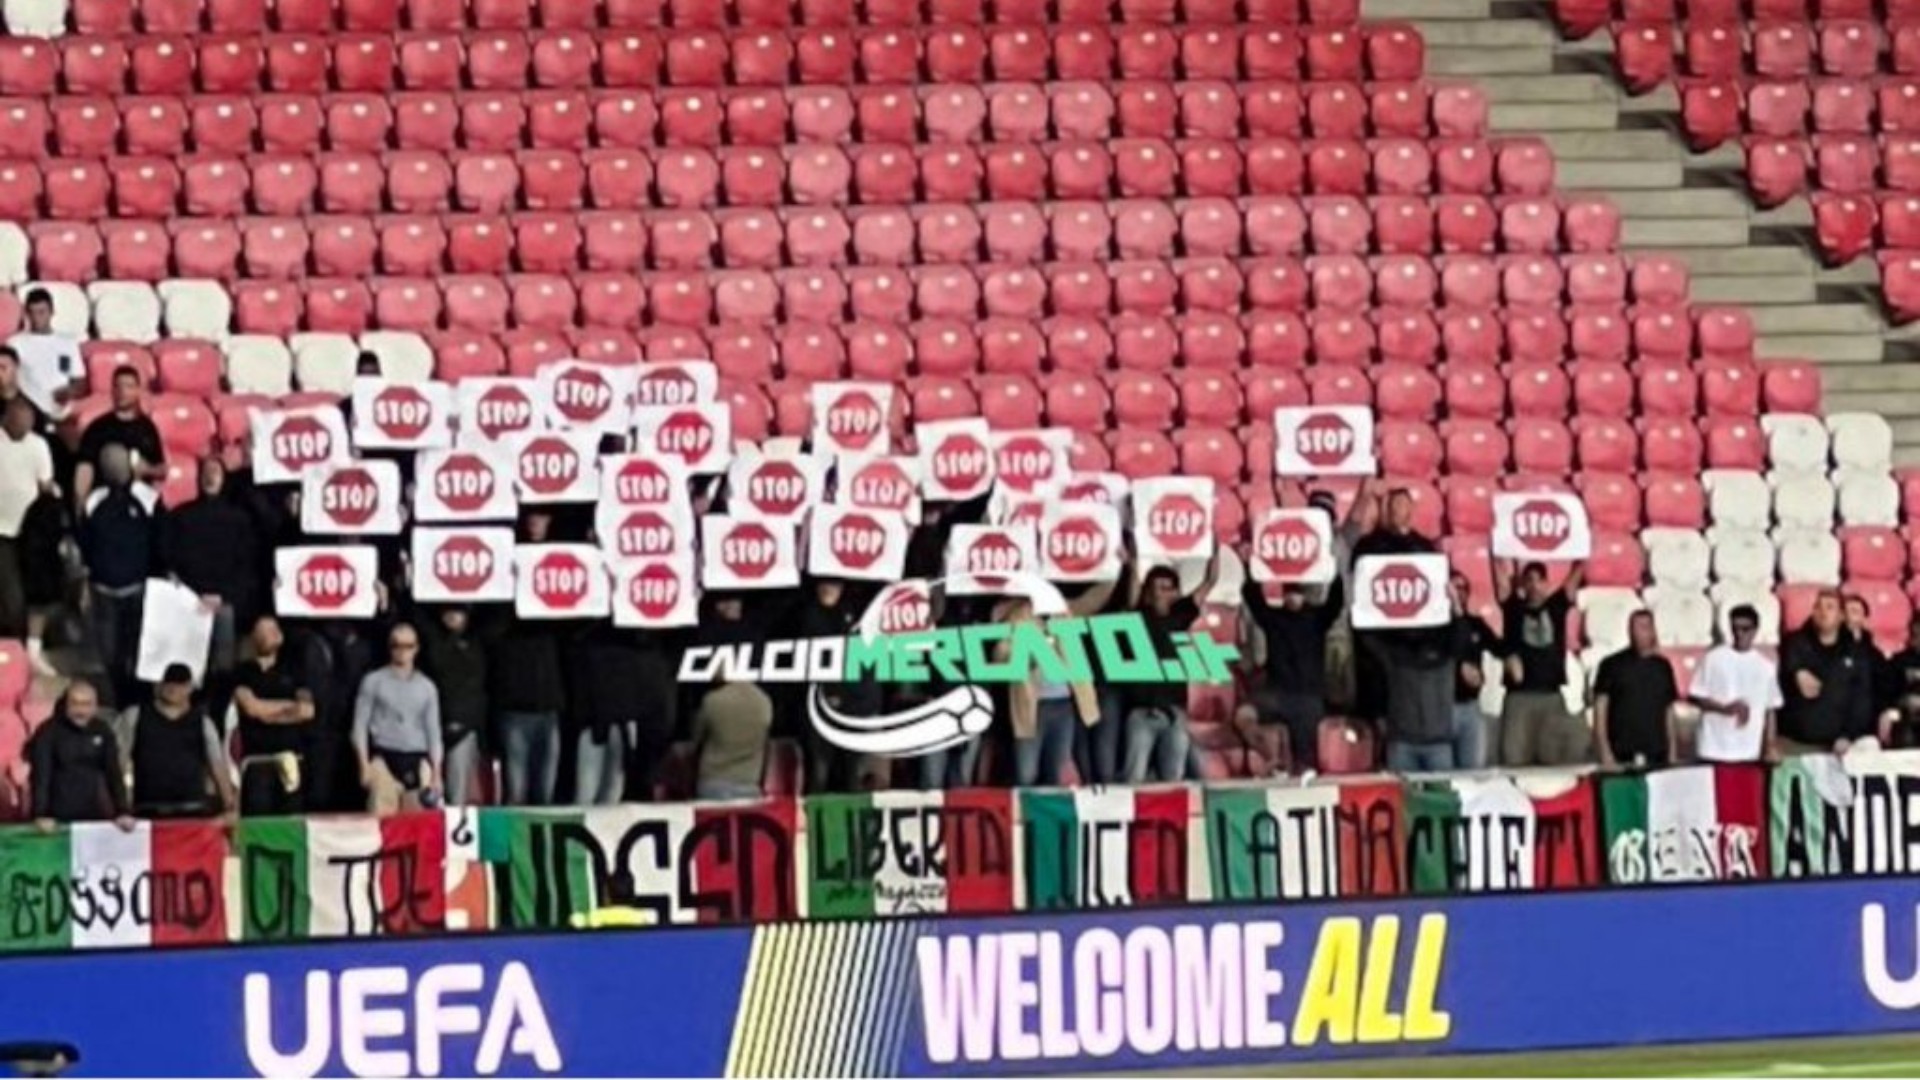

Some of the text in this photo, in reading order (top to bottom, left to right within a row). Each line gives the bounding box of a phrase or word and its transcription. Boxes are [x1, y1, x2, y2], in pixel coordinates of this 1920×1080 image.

[555, 381, 611, 407] STOP
[641, 381, 697, 402] STOP
[374, 402, 431, 425] STOP
[477, 402, 531, 425] STOP
[830, 407, 879, 433] STOP
[275, 433, 329, 457] STOP
[658, 425, 713, 450] STOP
[1299, 431, 1352, 453] STOP
[520, 454, 577, 478] STOP
[936, 450, 984, 478] STOP
[999, 451, 1050, 478] STOP
[435, 471, 493, 496] STOP
[616, 476, 669, 499] STOP
[751, 477, 805, 501] STOP
[854, 477, 907, 503] STOP
[323, 485, 378, 509] STOP
[1152, 510, 1205, 535] STOP
[1513, 514, 1569, 536] STOP
[619, 528, 674, 552] STOP
[724, 540, 776, 564] STOP
[833, 528, 885, 553] STOP
[1052, 532, 1104, 559] STOP
[1262, 534, 1319, 558] STOP
[434, 552, 492, 576] STOP
[969, 547, 1019, 572] STOP
[298, 570, 356, 594] STOP
[534, 568, 588, 592] STOP
[629, 578, 679, 602] STOP
[1373, 580, 1428, 602] STOP
[881, 603, 930, 629] STOP
[1216, 799, 1398, 899] LATINA
[917, 912, 1450, 1062] WELCOME ALL
[243, 963, 562, 1079] UEFA
